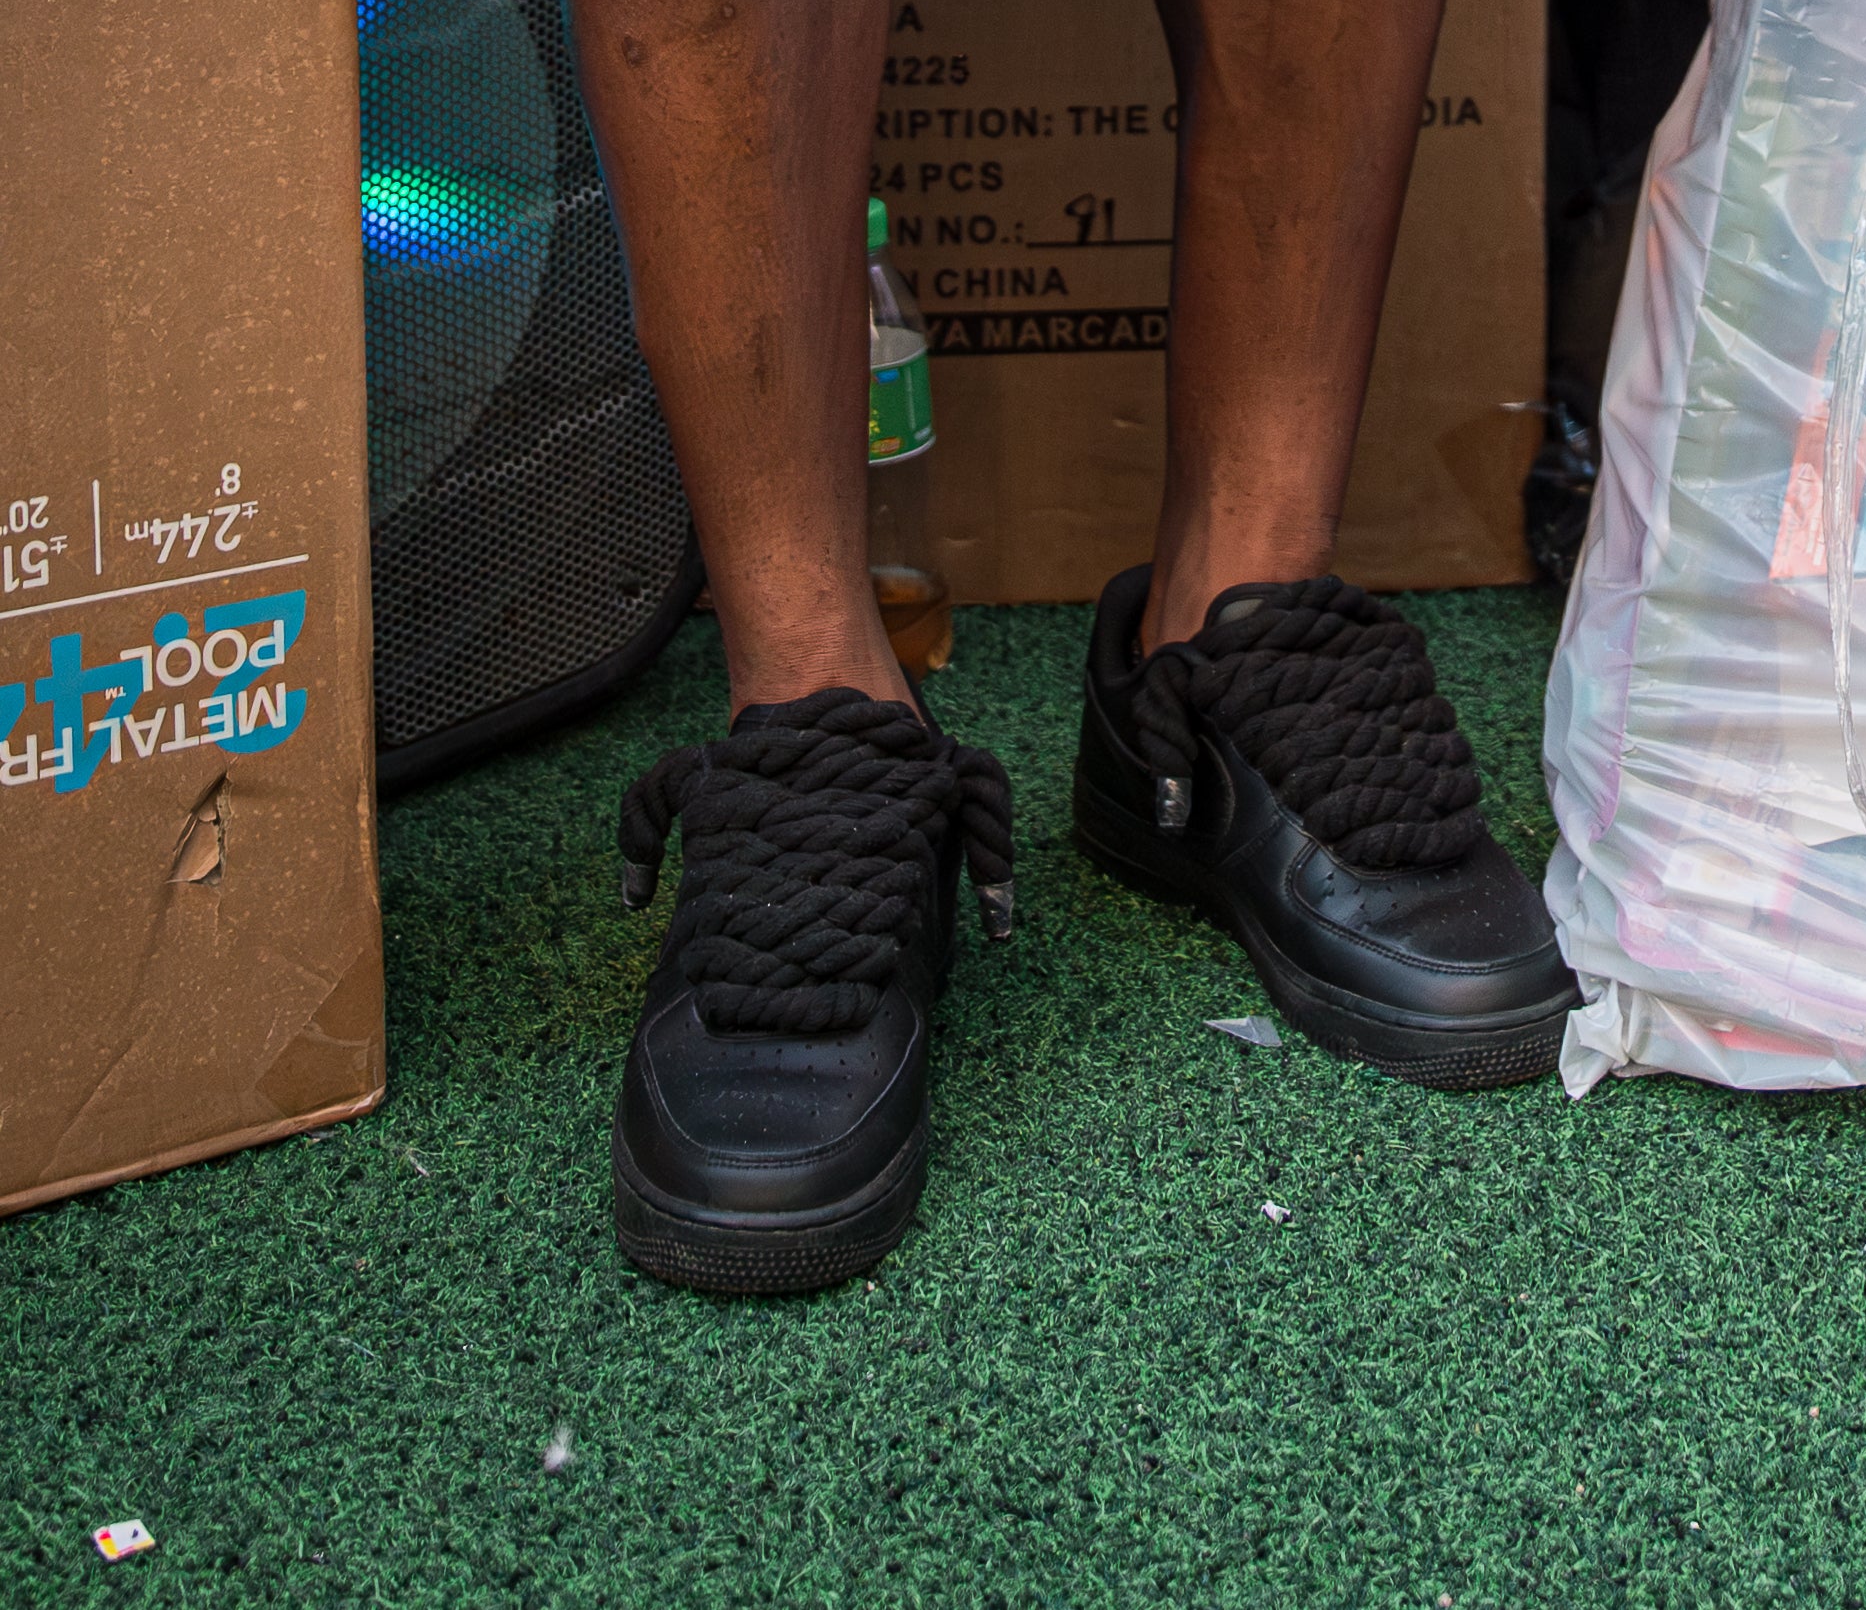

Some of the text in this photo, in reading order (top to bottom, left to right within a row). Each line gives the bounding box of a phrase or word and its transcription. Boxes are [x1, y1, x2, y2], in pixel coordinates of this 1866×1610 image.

[1066, 104, 1150, 136] THE
[919, 161, 1004, 193] PCS
[936, 214, 1026, 246] NO.:
[934, 266, 1070, 299] CHINA
[214, 462, 241, 496] 8'
[88, 681, 287, 765] METAL
